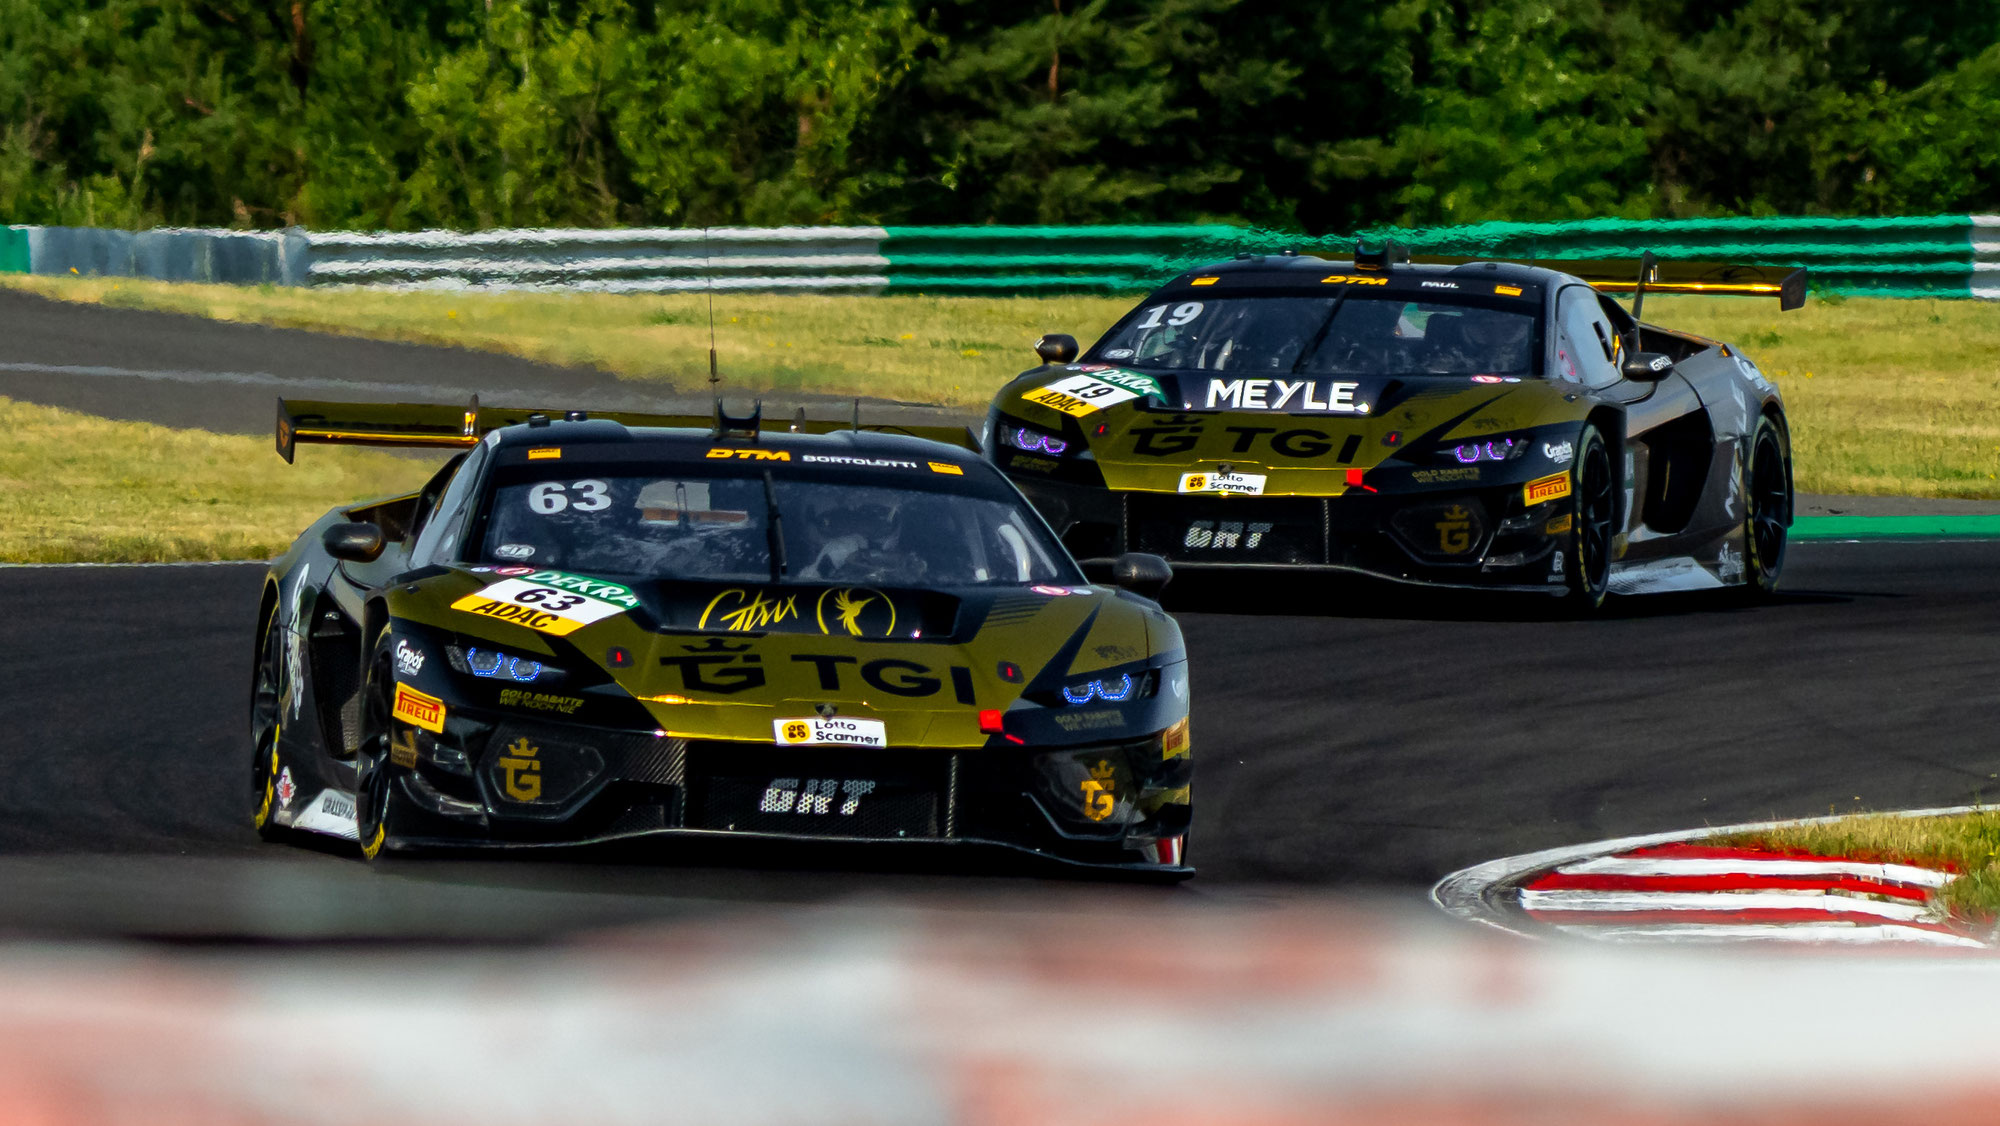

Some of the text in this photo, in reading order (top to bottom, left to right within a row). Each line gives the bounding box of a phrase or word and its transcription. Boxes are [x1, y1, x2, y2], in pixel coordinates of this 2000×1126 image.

[1320, 275, 1460, 289] DTM PAUL
[1137, 301, 1205, 329] 19
[1068, 382, 1115, 399] 19
[1034, 391, 1087, 412] ADAC
[1225, 426, 1363, 464] TGI
[706, 448, 791, 462] DTM
[802, 454, 918, 469] BORTOLOTTI
[1209, 481, 1259, 493] Scanner
[1212, 474, 1244, 483] Lotto
[1529, 476, 1567, 500] PIRELLI
[528, 480, 612, 514] 63
[525, 570, 640, 607] DEKRA
[514, 588, 587, 611] 63
[471, 600, 560, 628] ADAC
[790, 654, 976, 706] TGI
[397, 690, 440, 725] PIRELLI
[500, 688, 584, 708] GOLD RABATTE
[500, 697, 577, 715] WIE NOCH NIE
[815, 720, 857, 731] Lotto
[815, 731, 880, 745] Scanner
